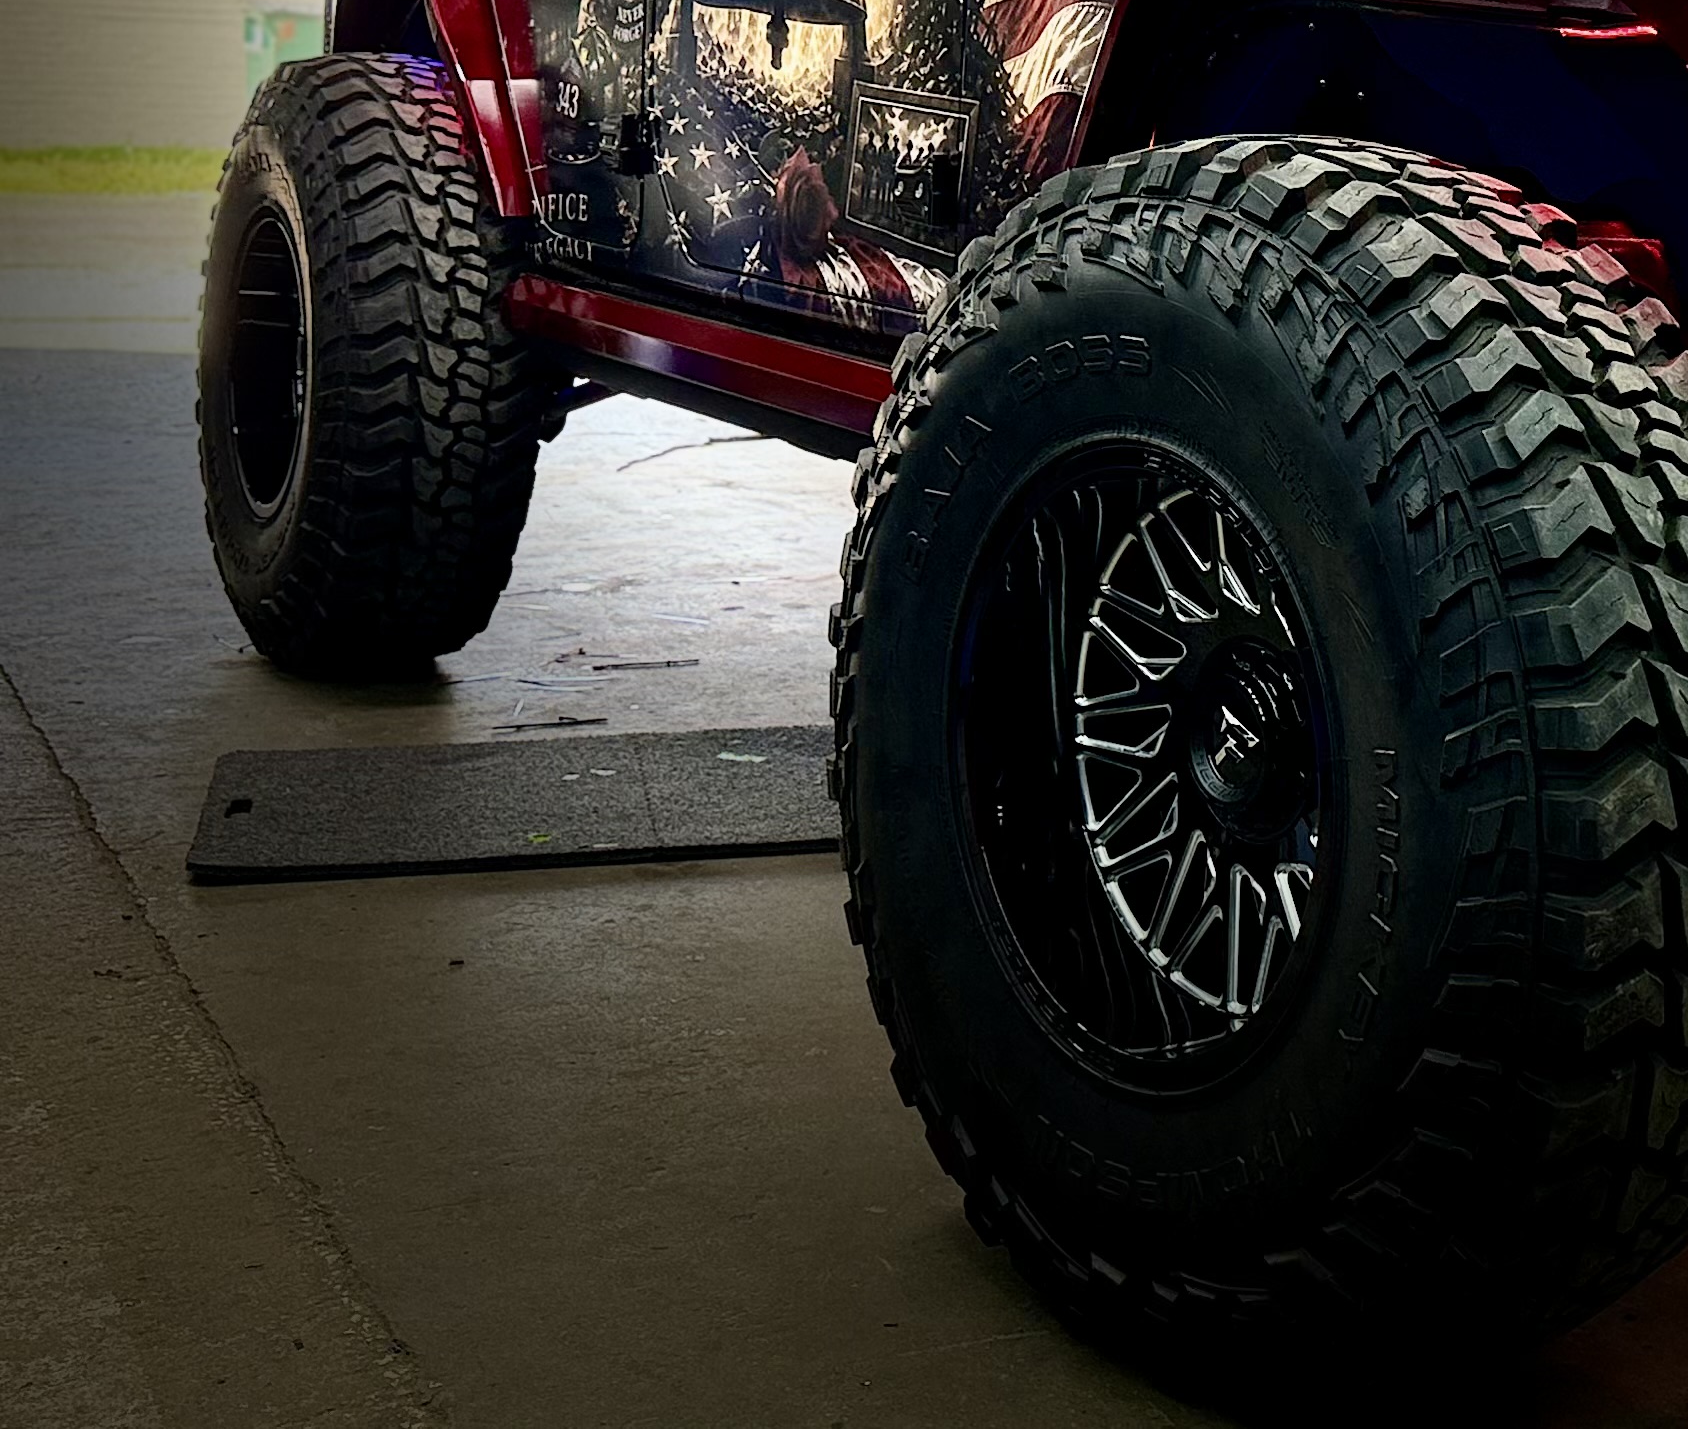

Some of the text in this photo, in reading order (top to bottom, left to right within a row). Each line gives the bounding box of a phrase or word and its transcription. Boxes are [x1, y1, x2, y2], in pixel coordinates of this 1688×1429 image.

[616, 3, 644, 24] NEVER
[556, 82, 580, 119] 343
[902, 332, 1153, 583] BAJA BOSS
